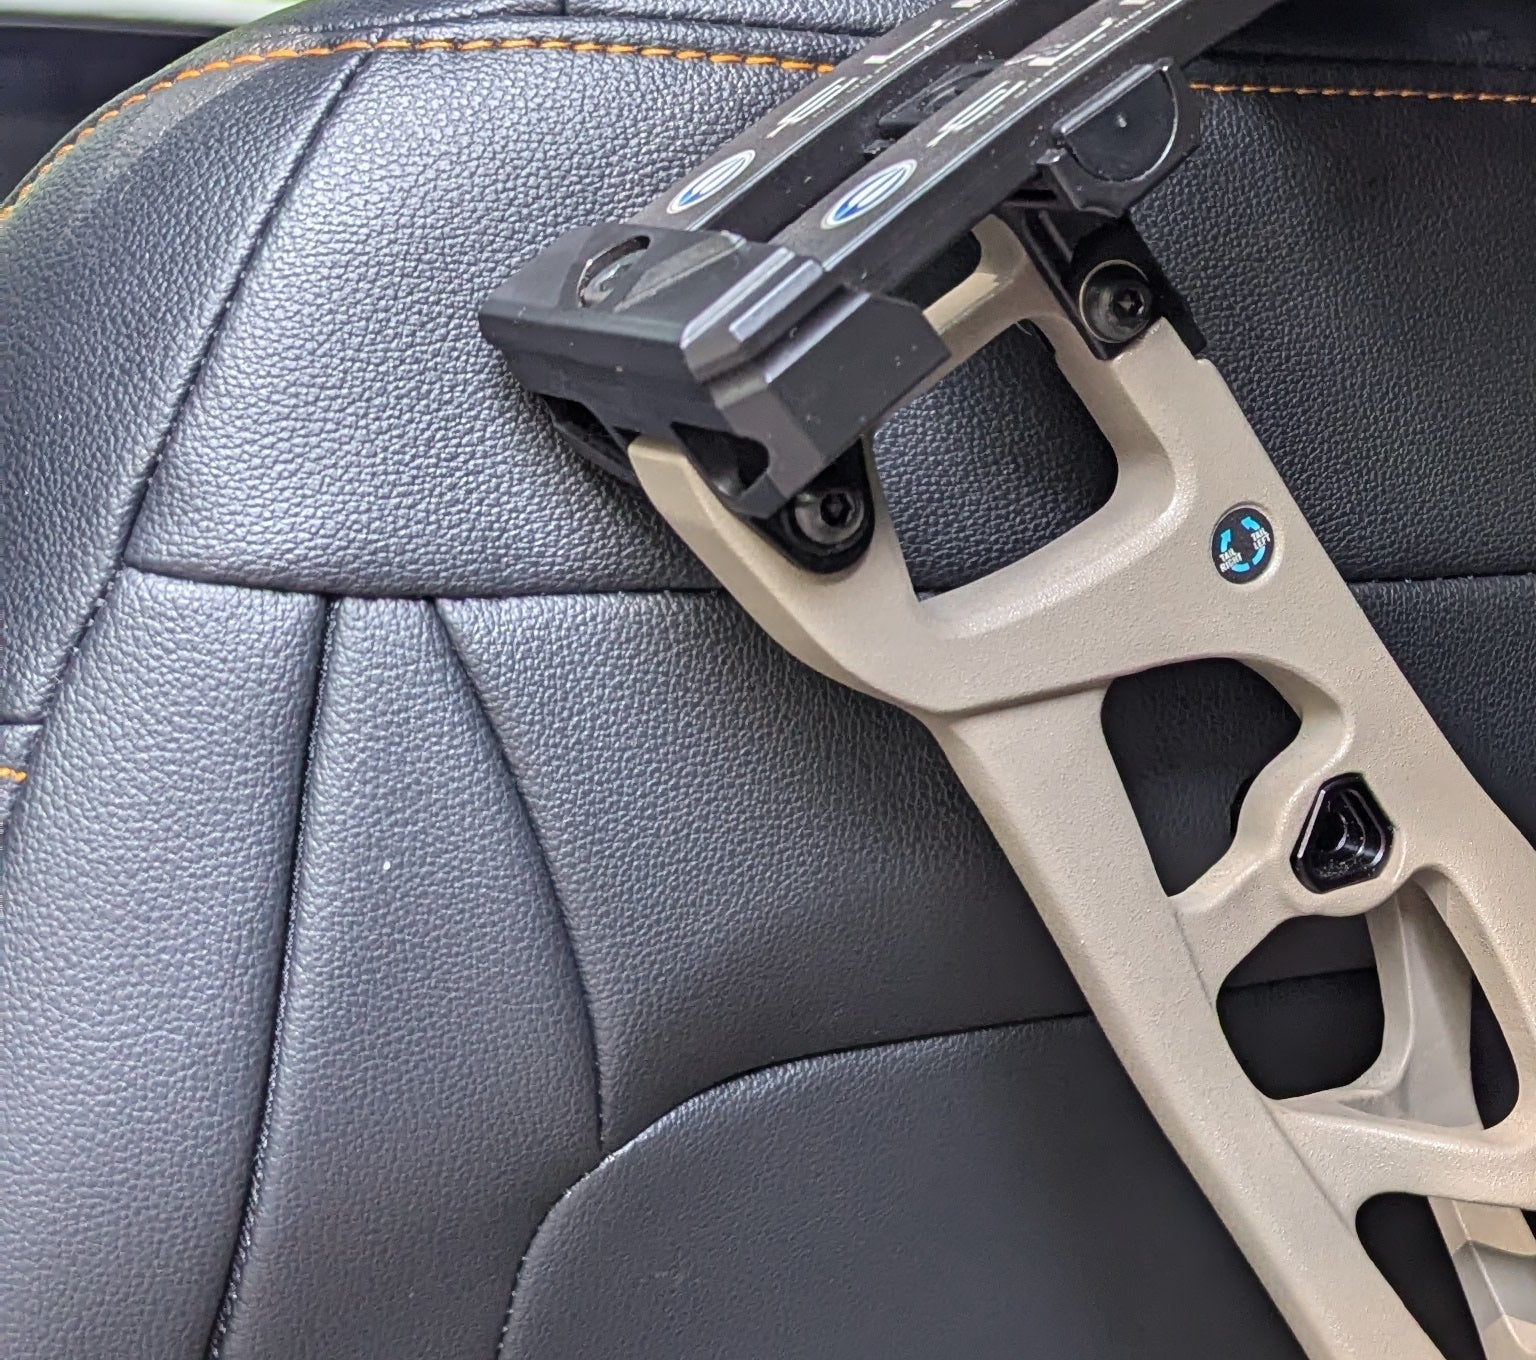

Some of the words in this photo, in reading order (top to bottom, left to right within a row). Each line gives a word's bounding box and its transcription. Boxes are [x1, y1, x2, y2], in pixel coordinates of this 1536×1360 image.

[1250, 527, 1270, 541] TAIL
[1252, 534, 1271, 550] LEFT
[1219, 547, 1237, 562] TAIL
[1219, 552, 1243, 573] RIGHT
